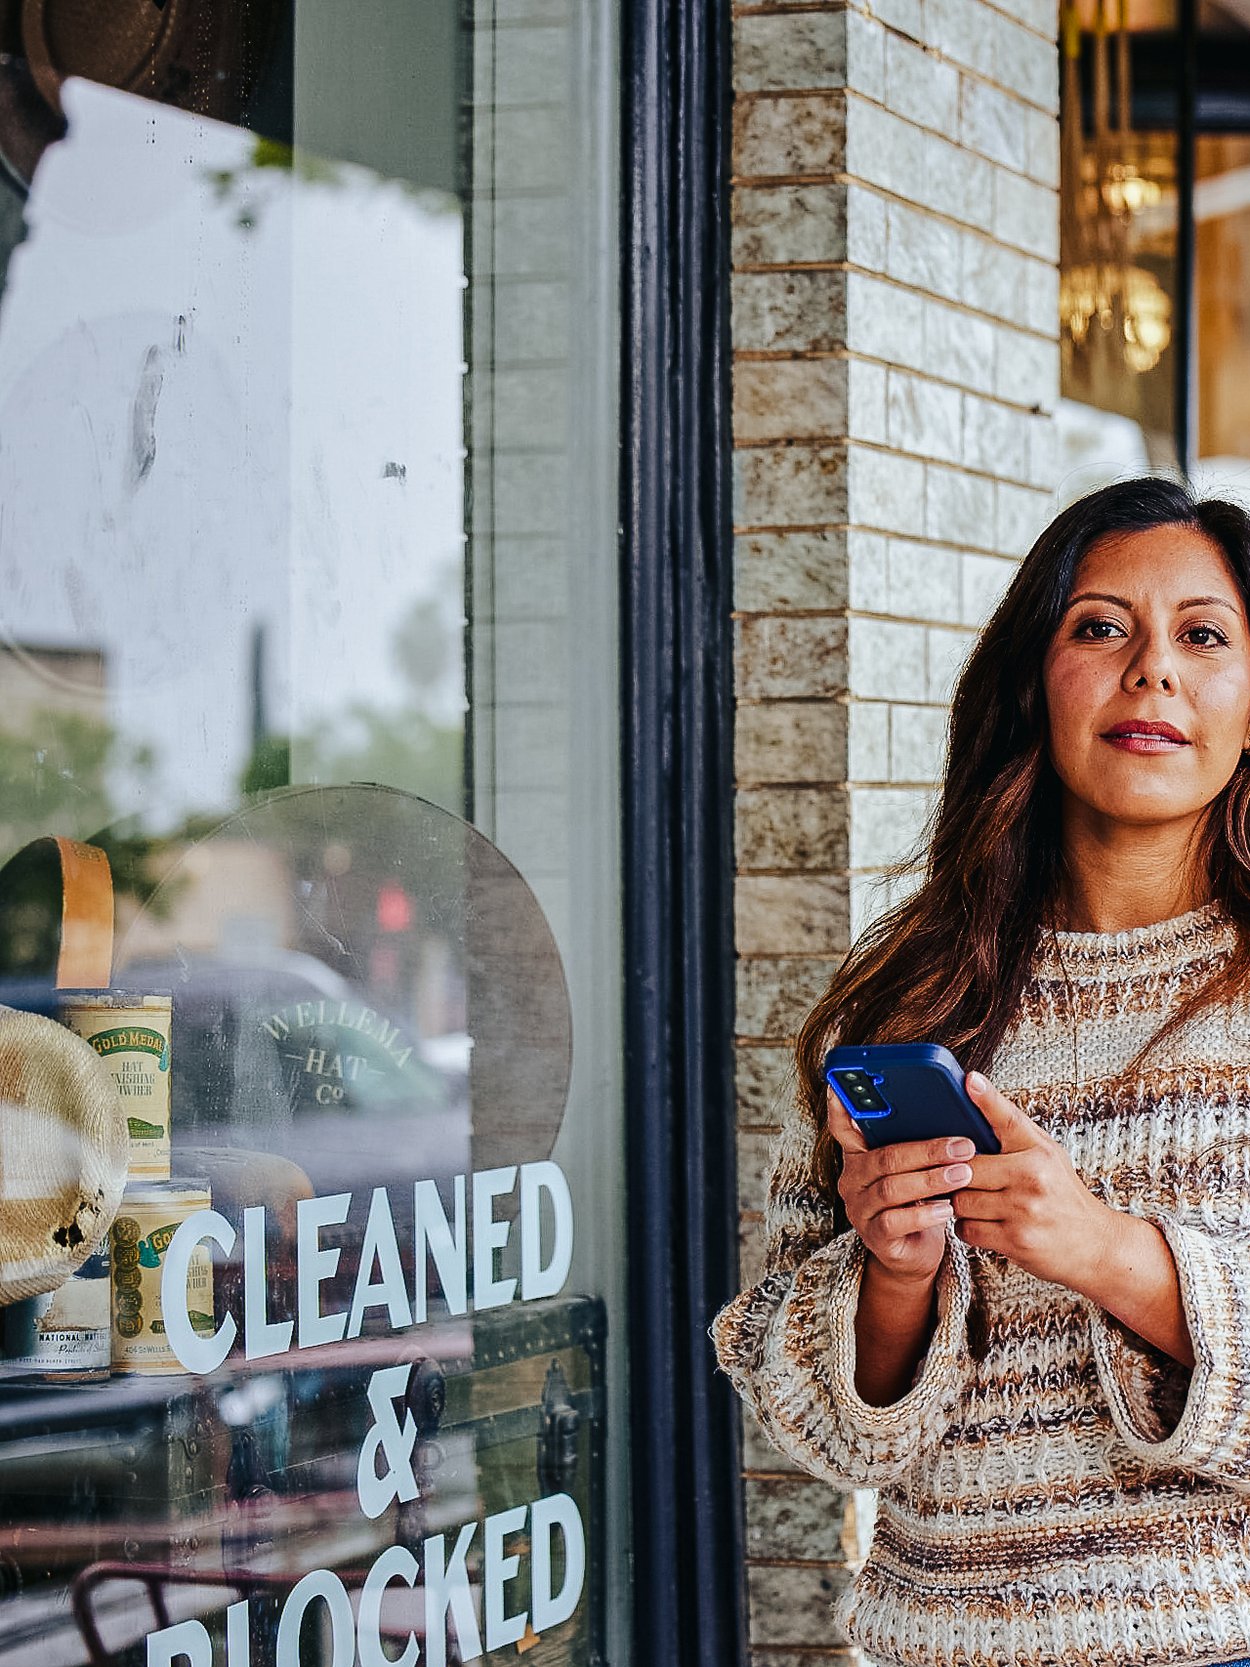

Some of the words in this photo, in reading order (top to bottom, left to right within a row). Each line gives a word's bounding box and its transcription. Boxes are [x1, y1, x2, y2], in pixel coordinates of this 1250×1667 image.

[92, 1032, 127, 1053] GOLD
[129, 1031, 164, 1051] MEDAL
[261, 1000, 413, 1069] WELLEMA
[122, 1061, 143, 1072] HAT
[304, 1047, 368, 1081] HAT
[161, 1160, 574, 1375] CLEANED
[39, 1333, 80, 1342] NATIONAL
[357, 1364, 420, 1520] &
